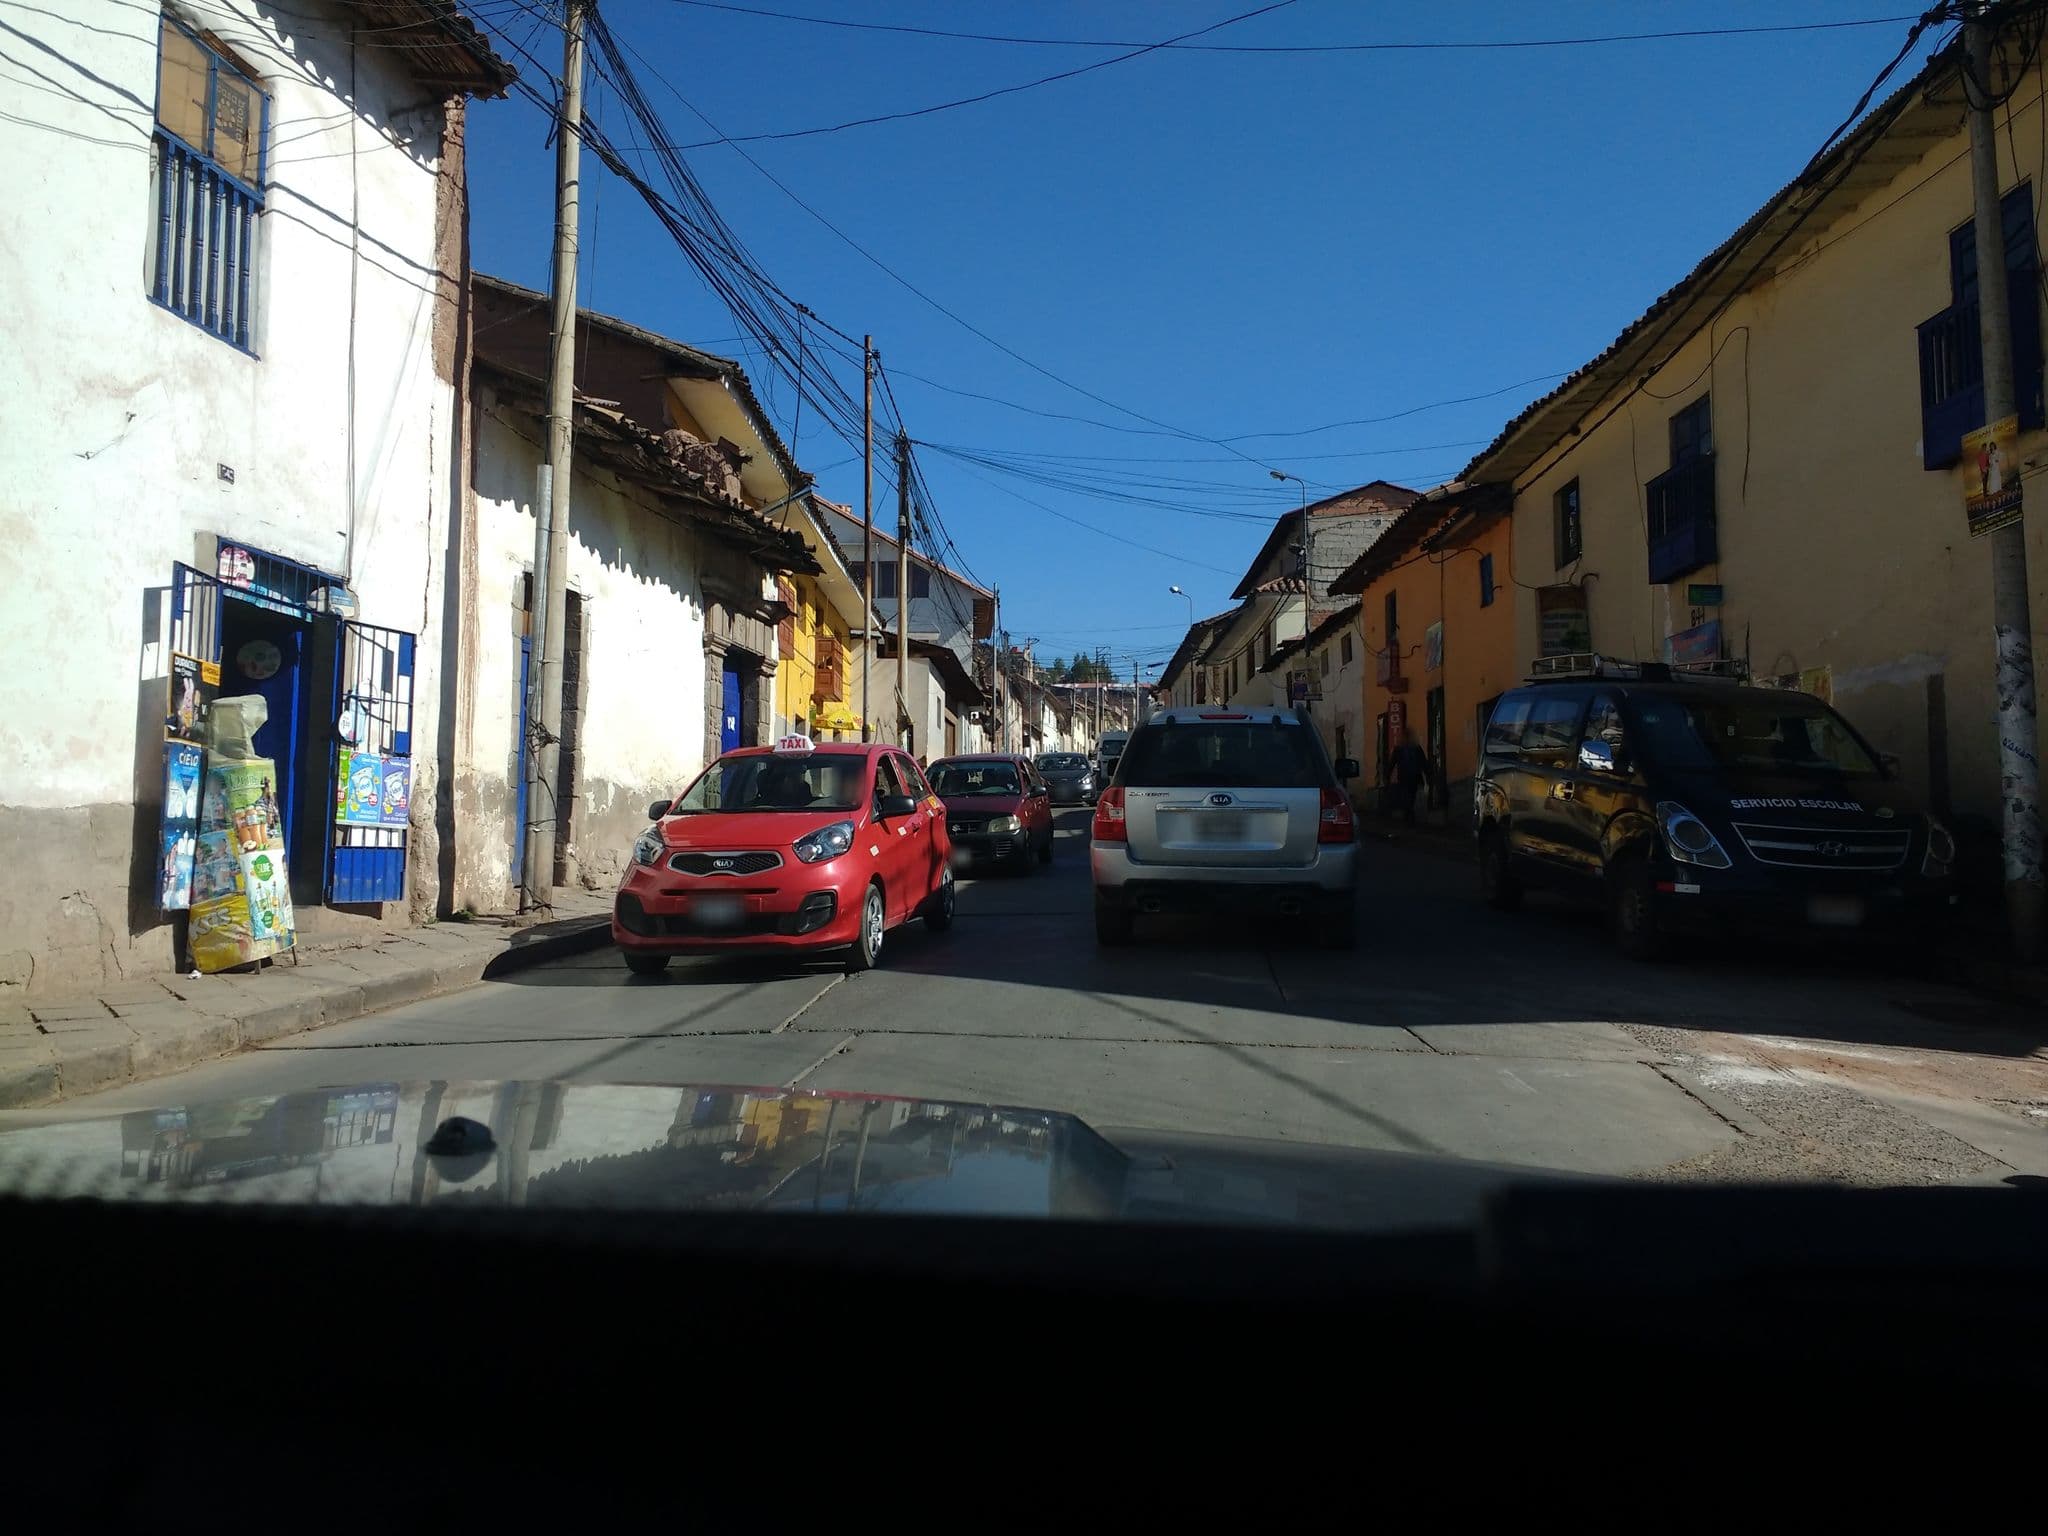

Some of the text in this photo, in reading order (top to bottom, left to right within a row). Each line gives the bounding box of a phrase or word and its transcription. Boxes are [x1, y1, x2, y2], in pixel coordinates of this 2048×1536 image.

[780, 738, 806, 749] TAXI
[178, 752, 199, 767] CIELO
[1730, 798, 1864, 812] SERVICIO ESCOLAR
[715, 859, 731, 867] KIA
